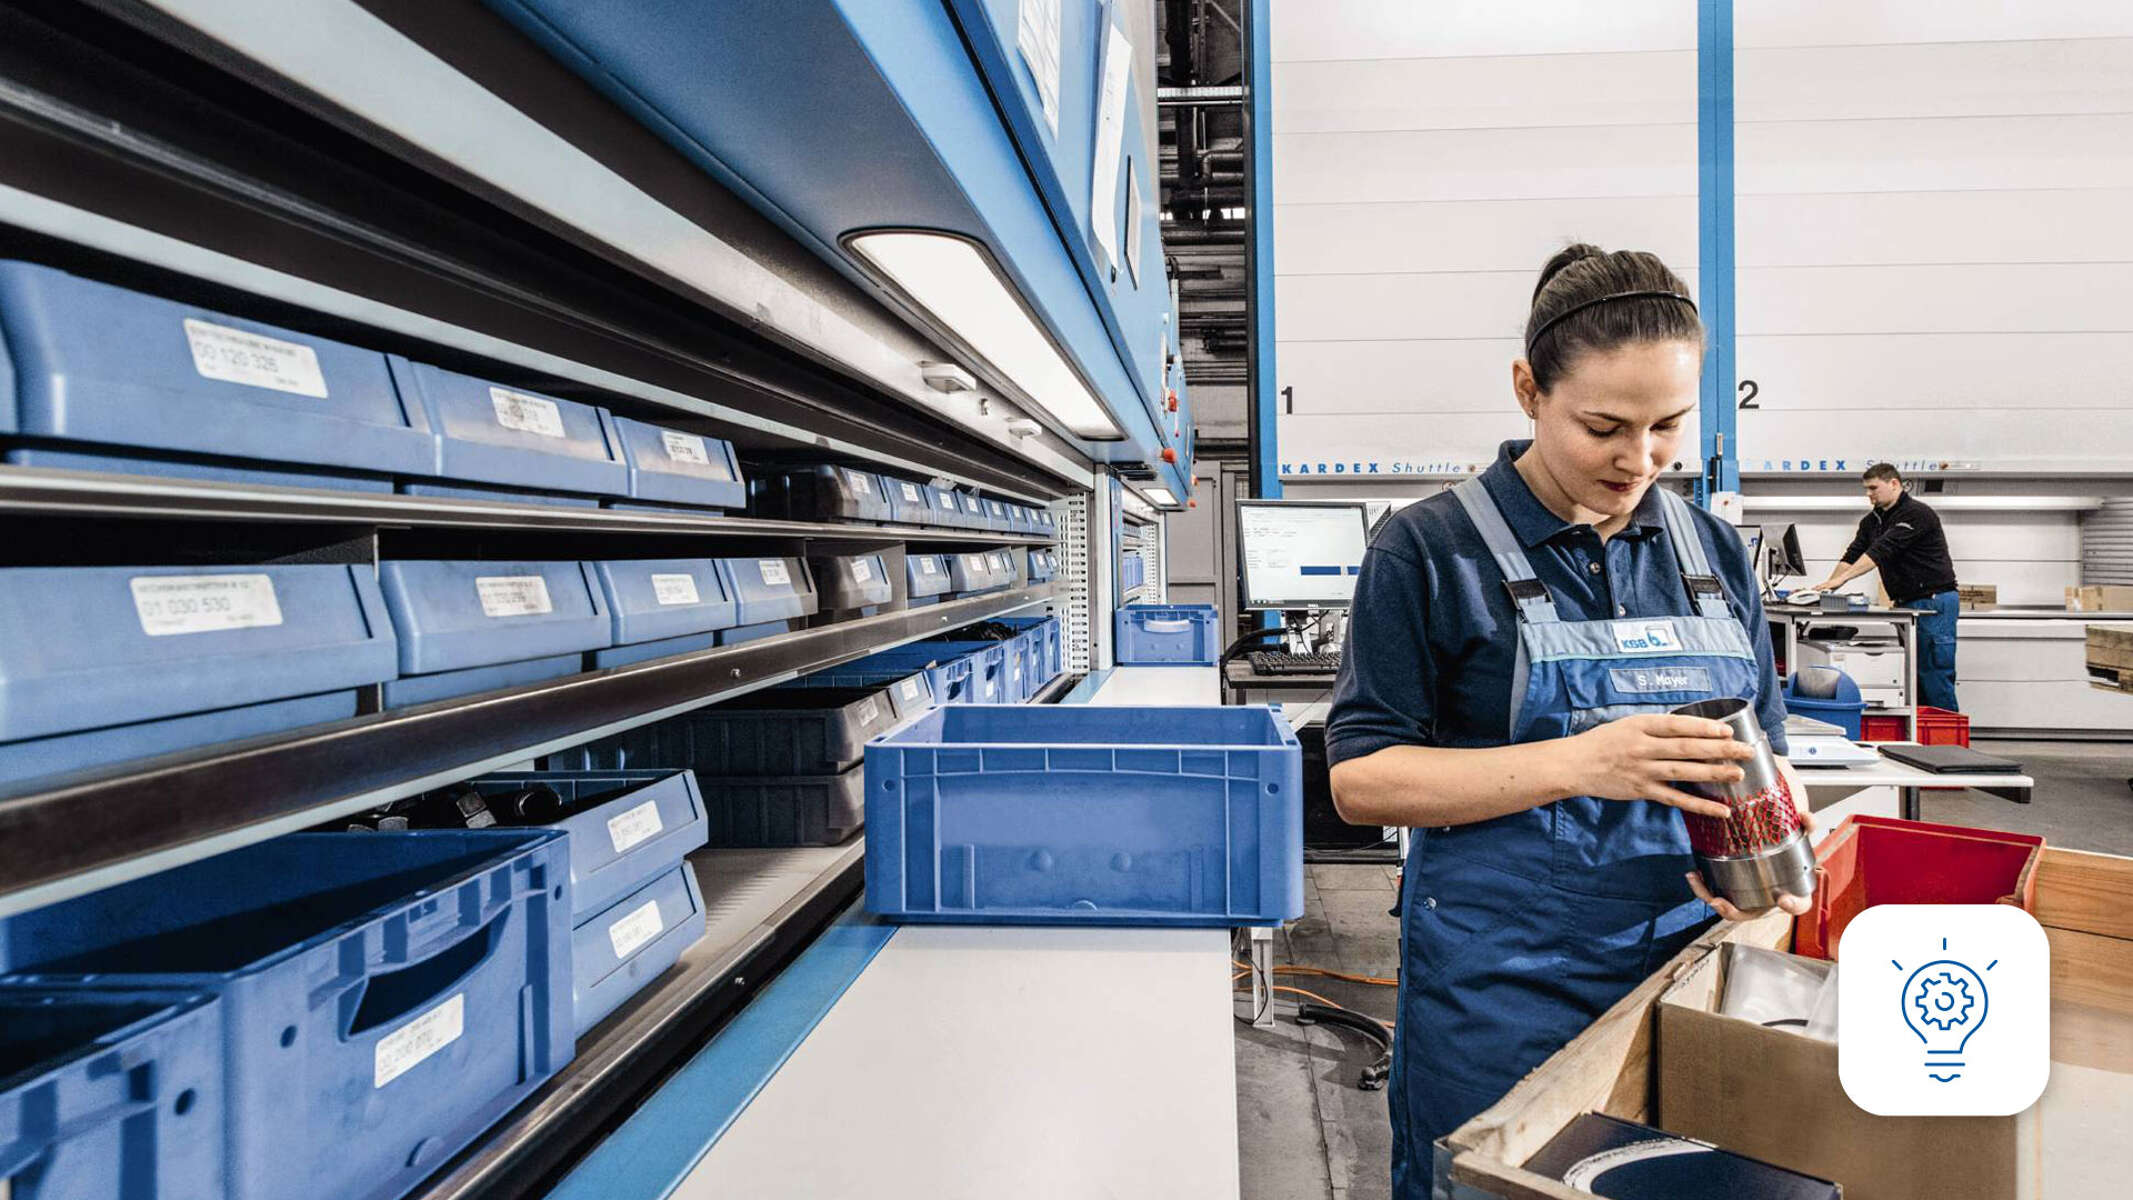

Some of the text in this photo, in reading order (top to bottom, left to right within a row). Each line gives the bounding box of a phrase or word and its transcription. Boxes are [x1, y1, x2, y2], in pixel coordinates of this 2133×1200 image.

[1280, 386, 1293, 415] 1
[1738, 379, 1760, 410] 2
[1281, 461, 1462, 475] KARDEX Shuttle
[1744, 458, 1938, 471] ARDEX Sttle
[1655, 674, 1689, 688] Mayer
